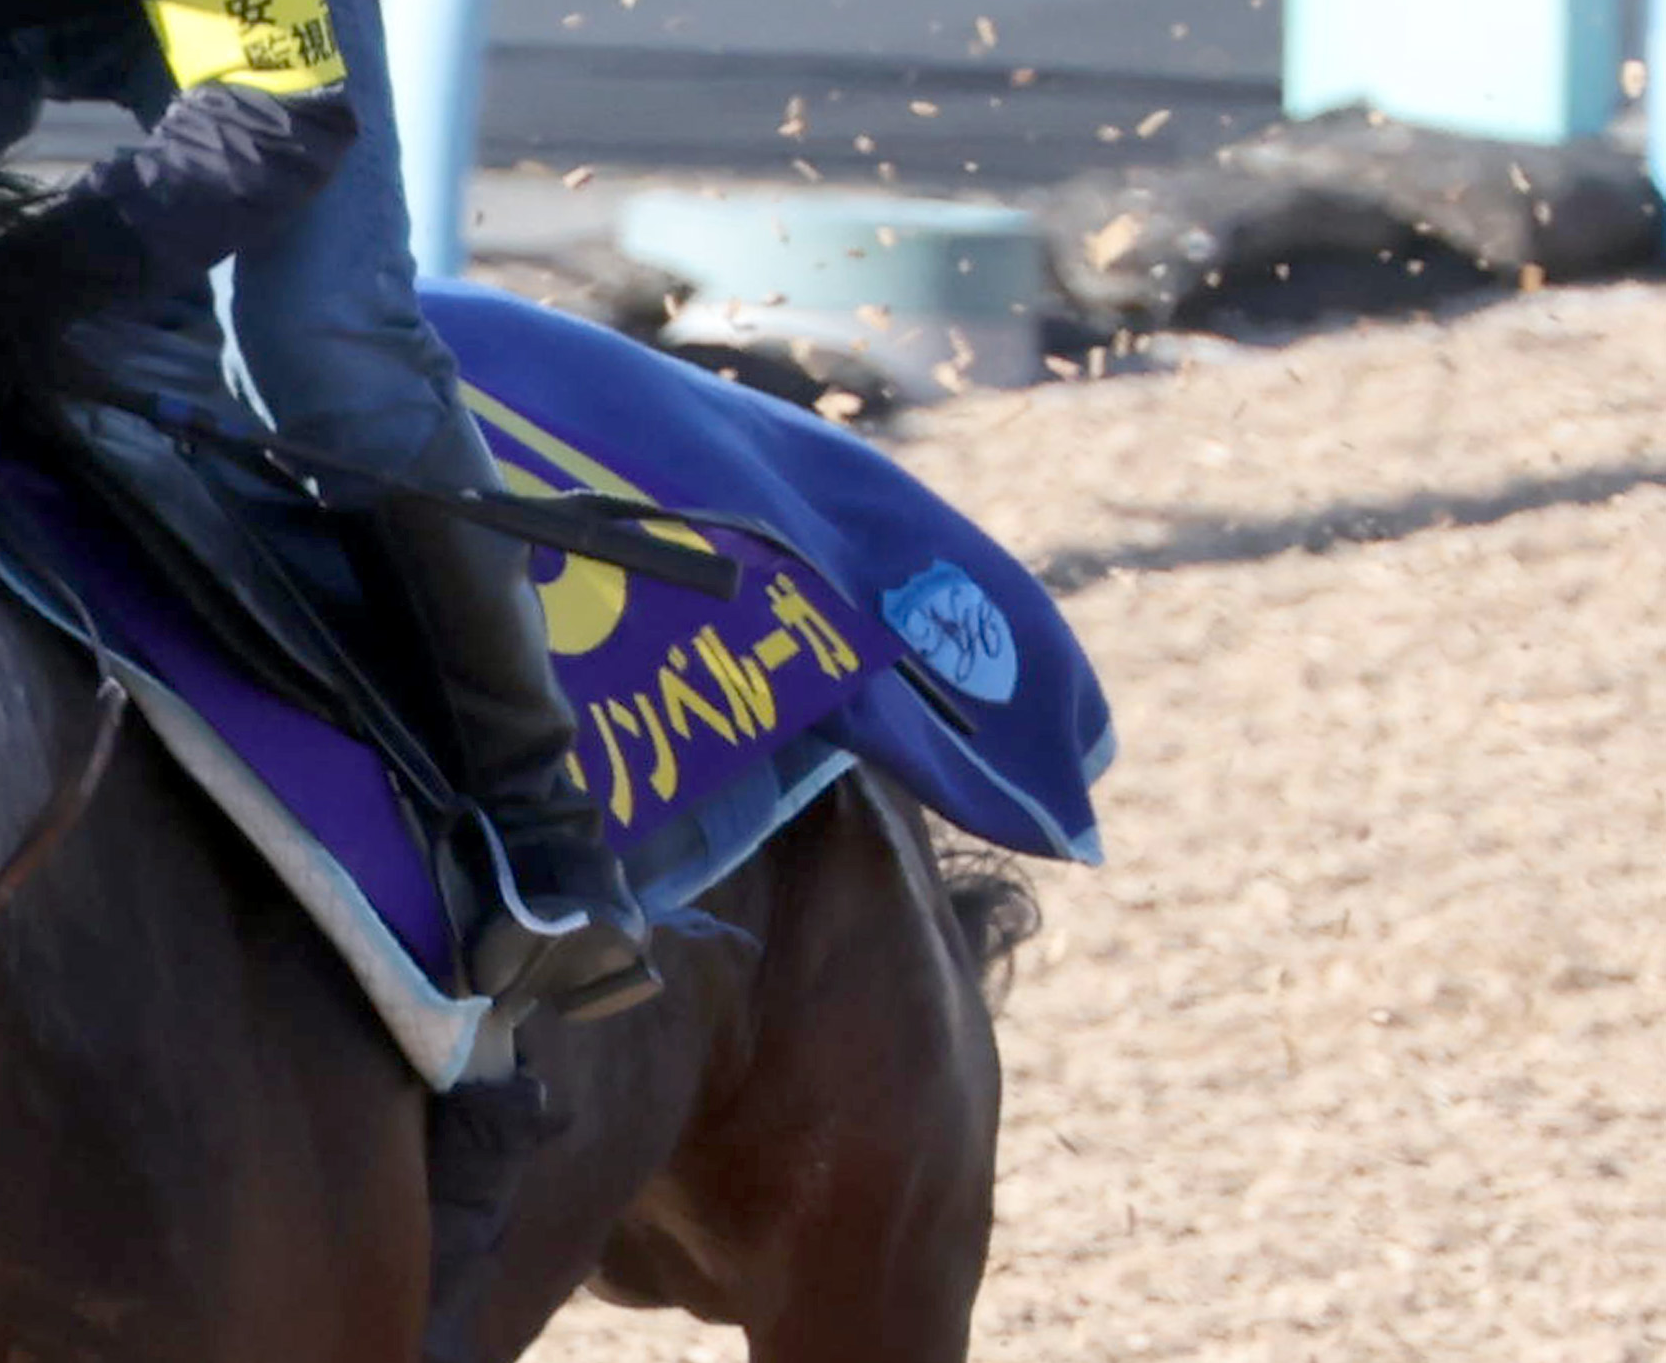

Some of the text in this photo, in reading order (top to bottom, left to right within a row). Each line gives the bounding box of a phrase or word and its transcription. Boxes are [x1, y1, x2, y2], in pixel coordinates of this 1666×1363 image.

[244, 19, 336, 70] 監視
[565, 571, 859, 828] ノンベルーガ
